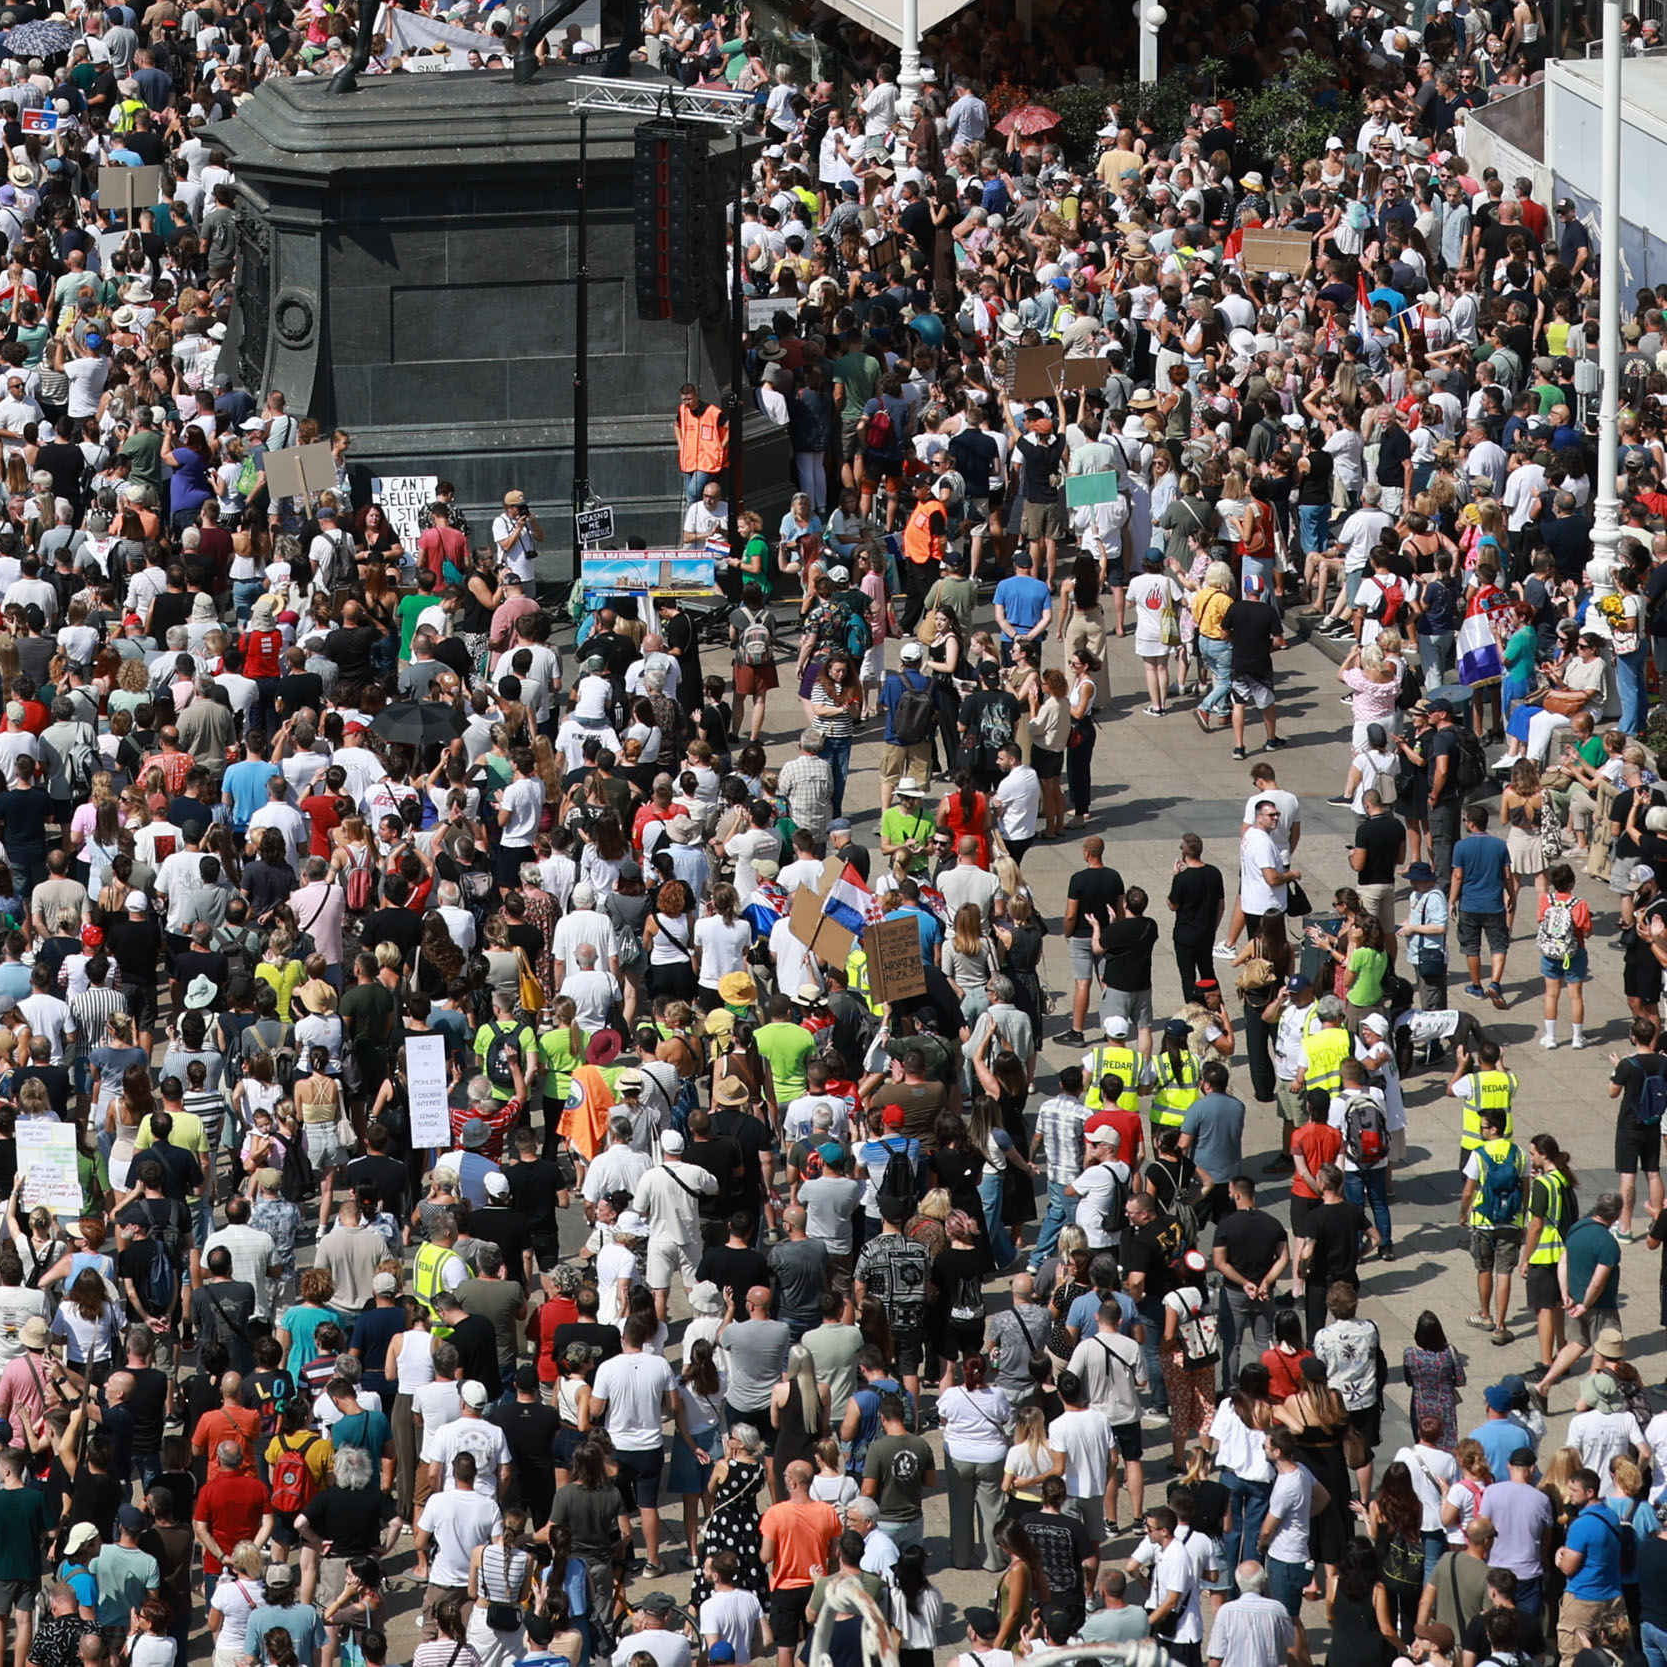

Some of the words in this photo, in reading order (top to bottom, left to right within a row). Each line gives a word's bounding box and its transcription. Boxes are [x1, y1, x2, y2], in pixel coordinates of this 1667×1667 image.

[379, 492, 431, 506] BELIEVE
[417, 1043, 431, 1051] HDZ
[1103, 1060, 1133, 1071] REDAR
[1481, 1084, 1509, 1093] REDAR
[419, 1092, 442, 1100] OSOBNI
[416, 1100, 441, 1108] INTERES
